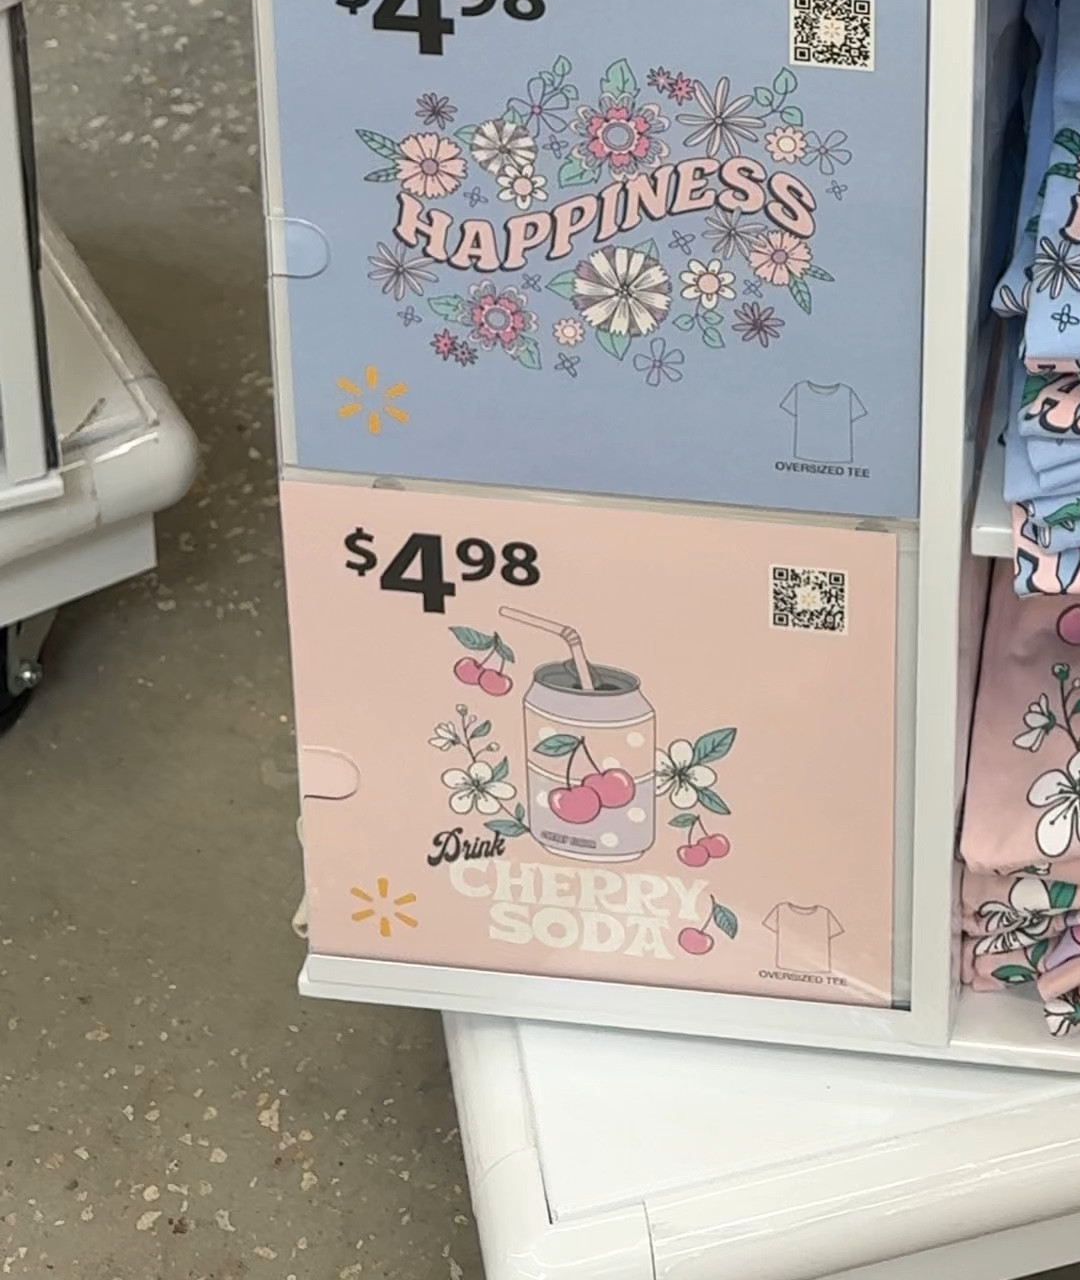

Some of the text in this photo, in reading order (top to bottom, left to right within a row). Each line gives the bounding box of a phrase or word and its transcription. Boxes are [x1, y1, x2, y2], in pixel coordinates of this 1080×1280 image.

[394, 155, 818, 274] HAPPINESS
[774, 461, 870, 479] OVERSIZED TEE
[427, 827, 506, 867] Drink
[450, 860, 710, 921] CHERRY
[489, 901, 675, 960] SODA
[758, 968, 849, 987] OVERSIZED TEE
